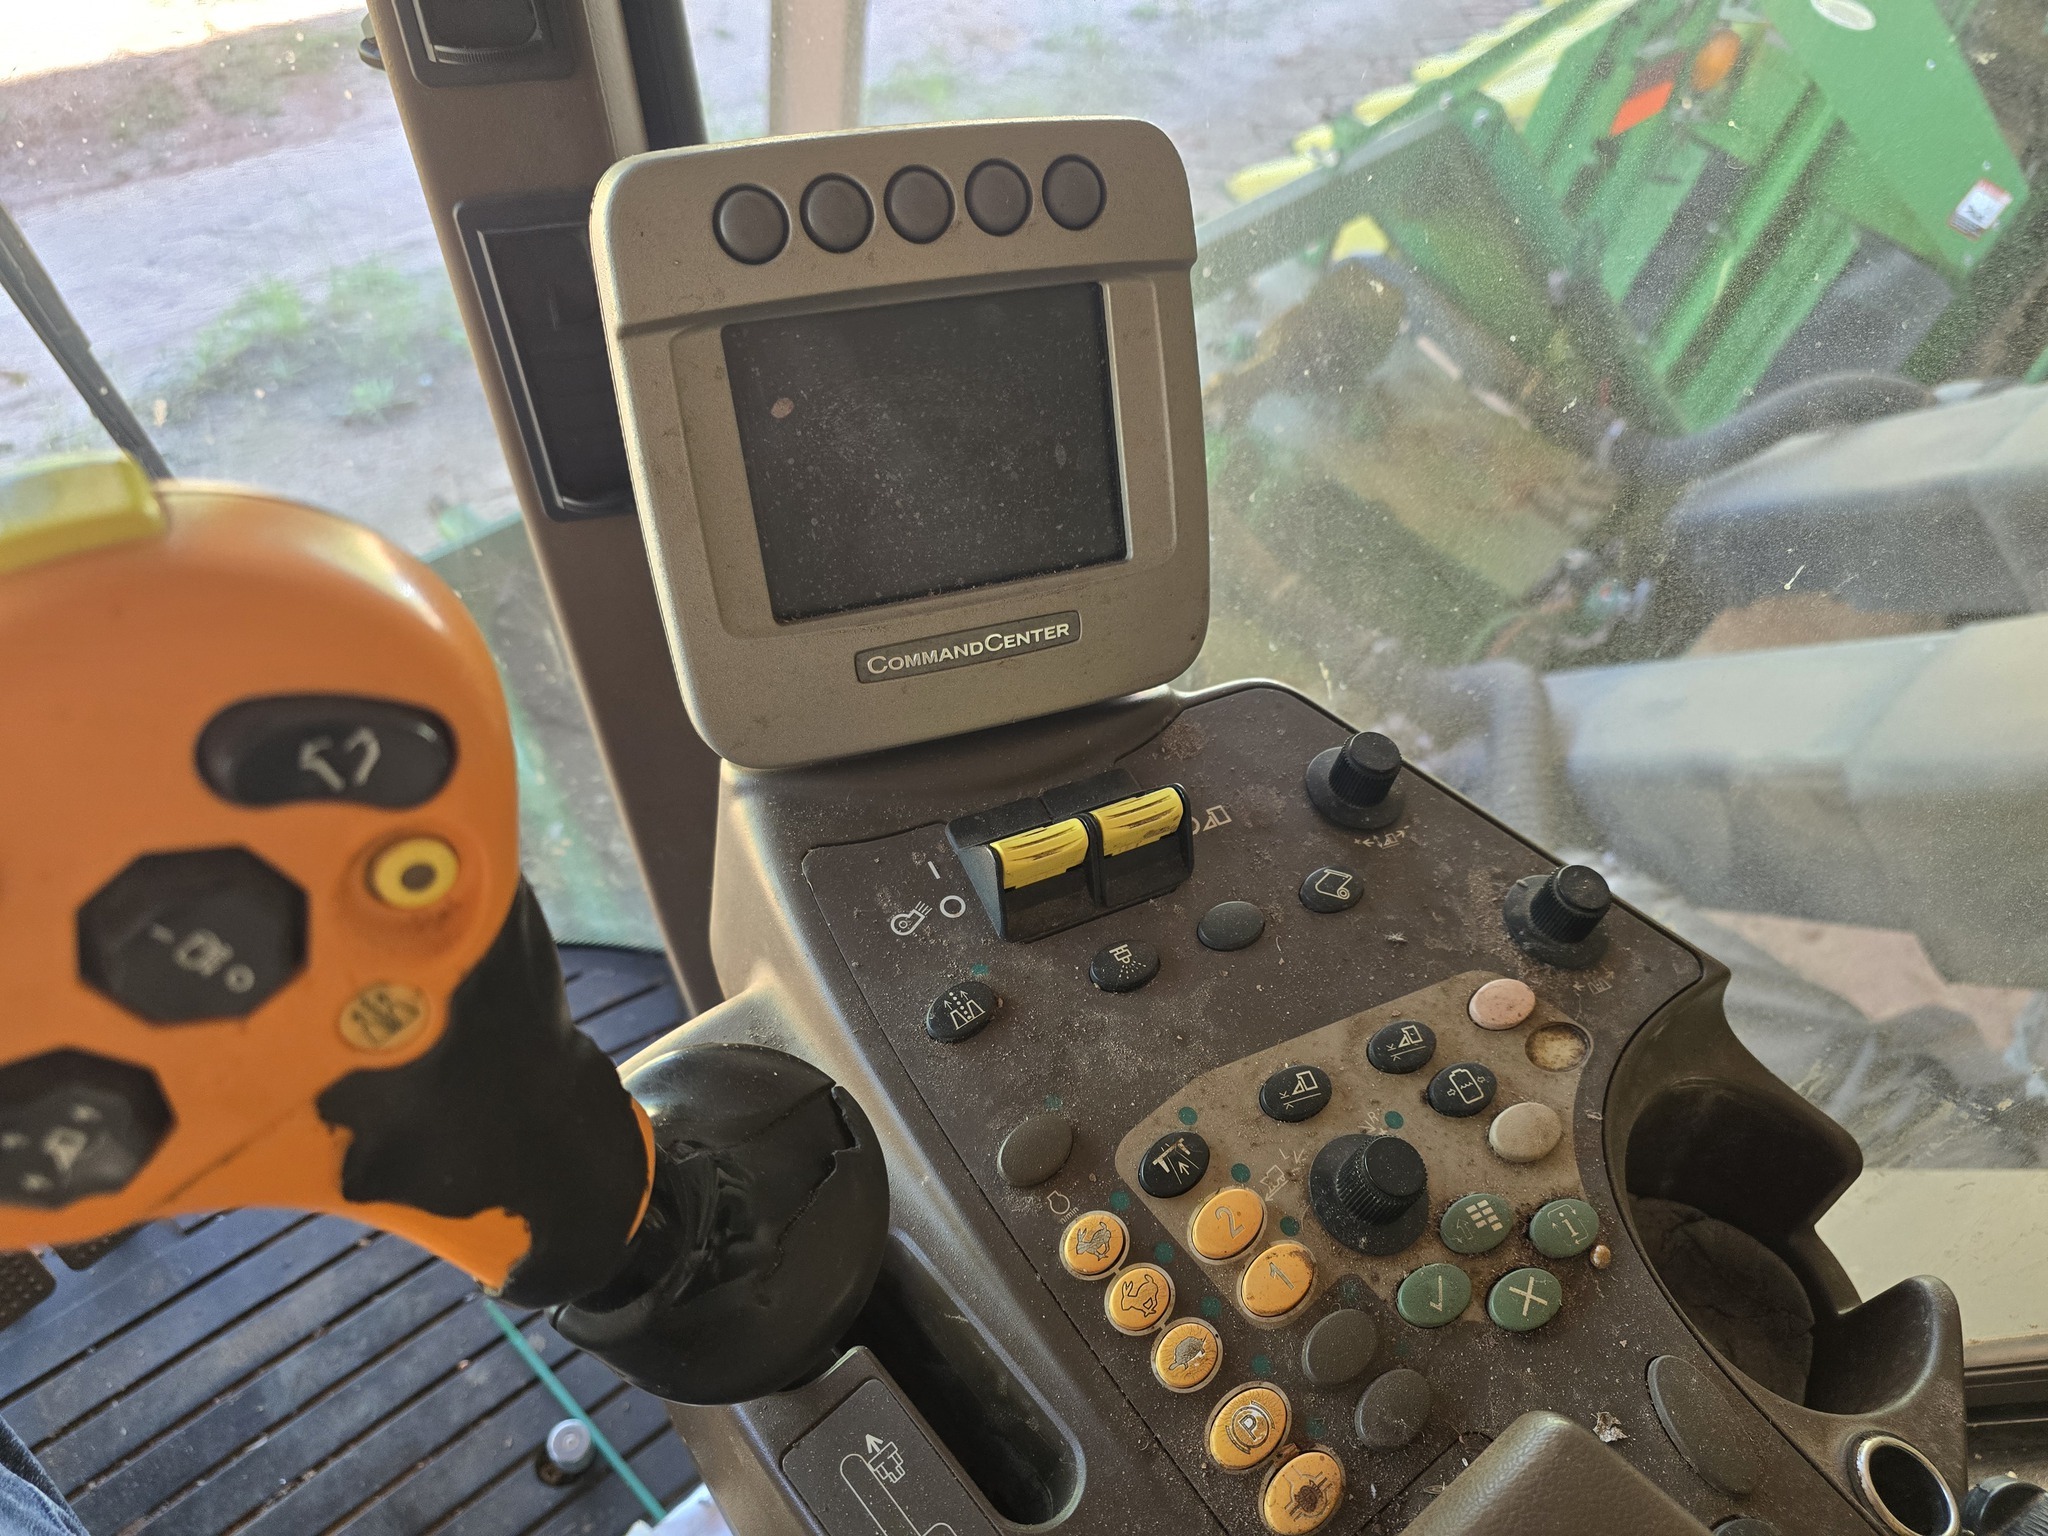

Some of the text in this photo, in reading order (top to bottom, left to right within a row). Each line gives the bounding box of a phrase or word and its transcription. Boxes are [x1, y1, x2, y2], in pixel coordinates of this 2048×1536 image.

[1214, 1205, 1246, 1240] 2
[1268, 1261, 1295, 1291] 1
[1238, 1413, 1257, 1441] P
